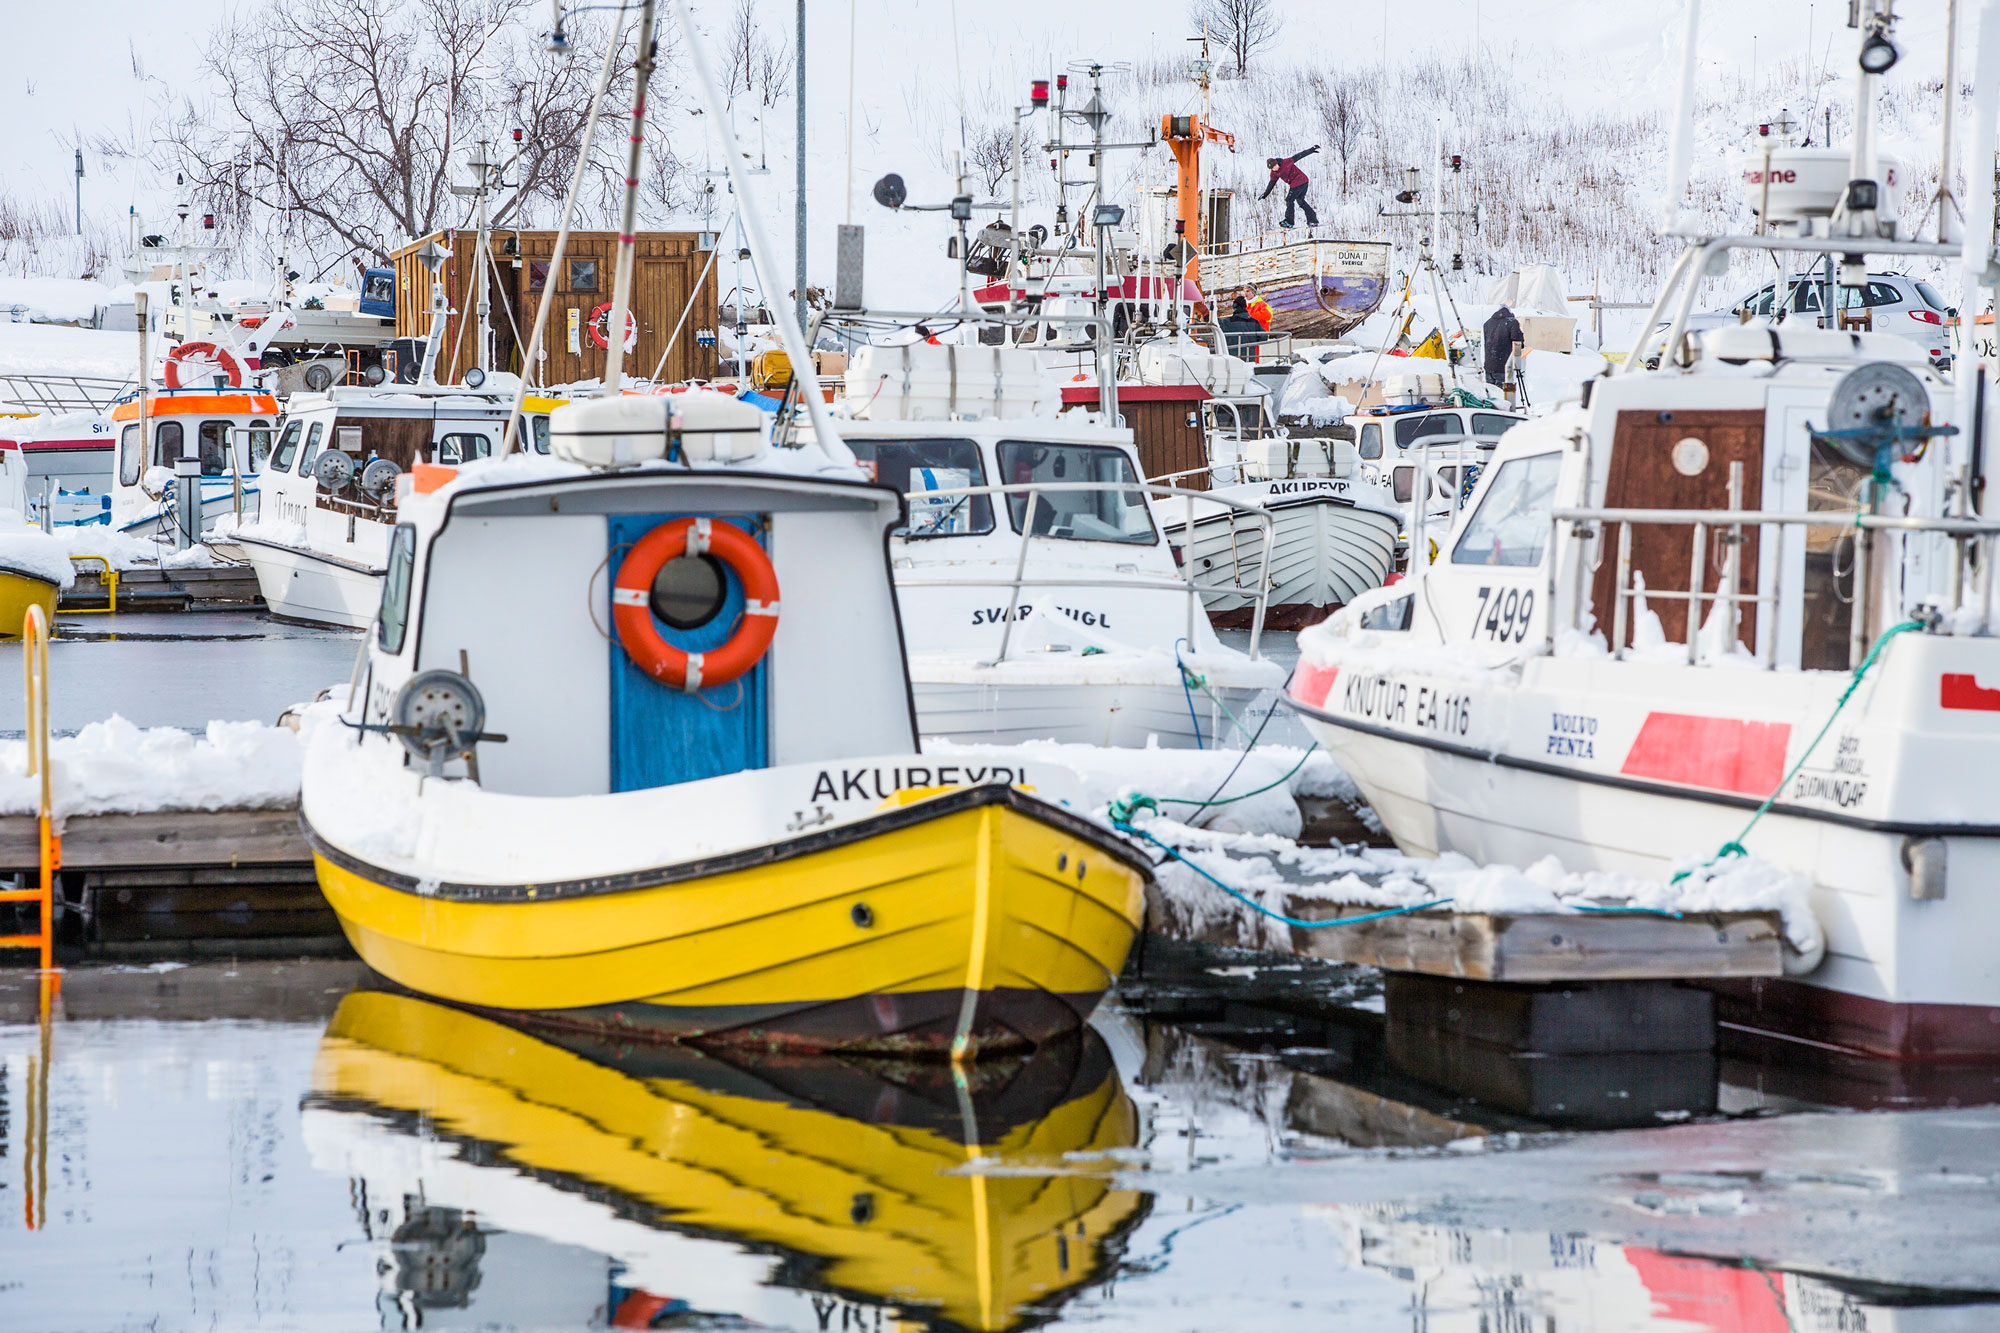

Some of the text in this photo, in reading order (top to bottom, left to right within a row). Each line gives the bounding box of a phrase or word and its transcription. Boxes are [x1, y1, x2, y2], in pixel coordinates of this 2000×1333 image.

[1471, 586, 1534, 644] 7499
[1416, 687, 1438, 730] EA
[1444, 692, 1472, 736] 116
[1552, 712, 1598, 736] VOLVO
[1546, 735, 1594, 759] PENTA
